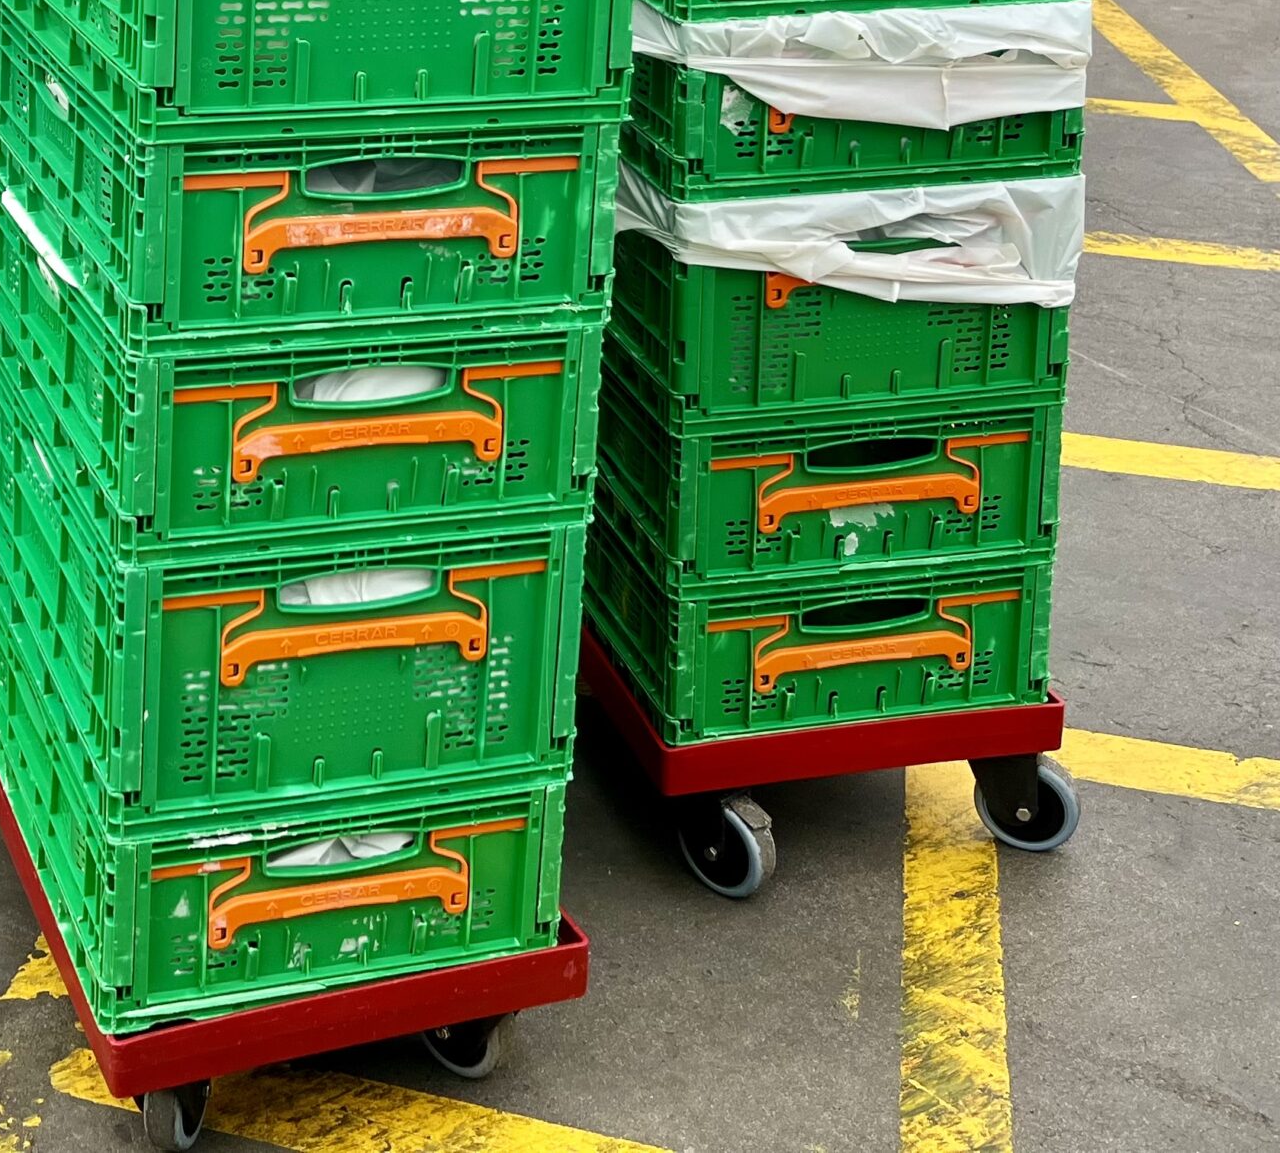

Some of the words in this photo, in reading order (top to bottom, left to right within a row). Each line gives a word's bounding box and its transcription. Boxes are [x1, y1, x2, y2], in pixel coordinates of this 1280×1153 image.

[328, 422, 411, 441] CERRAR
[315, 625, 399, 646] CERRAR
[300, 884, 381, 907] CERRAR
